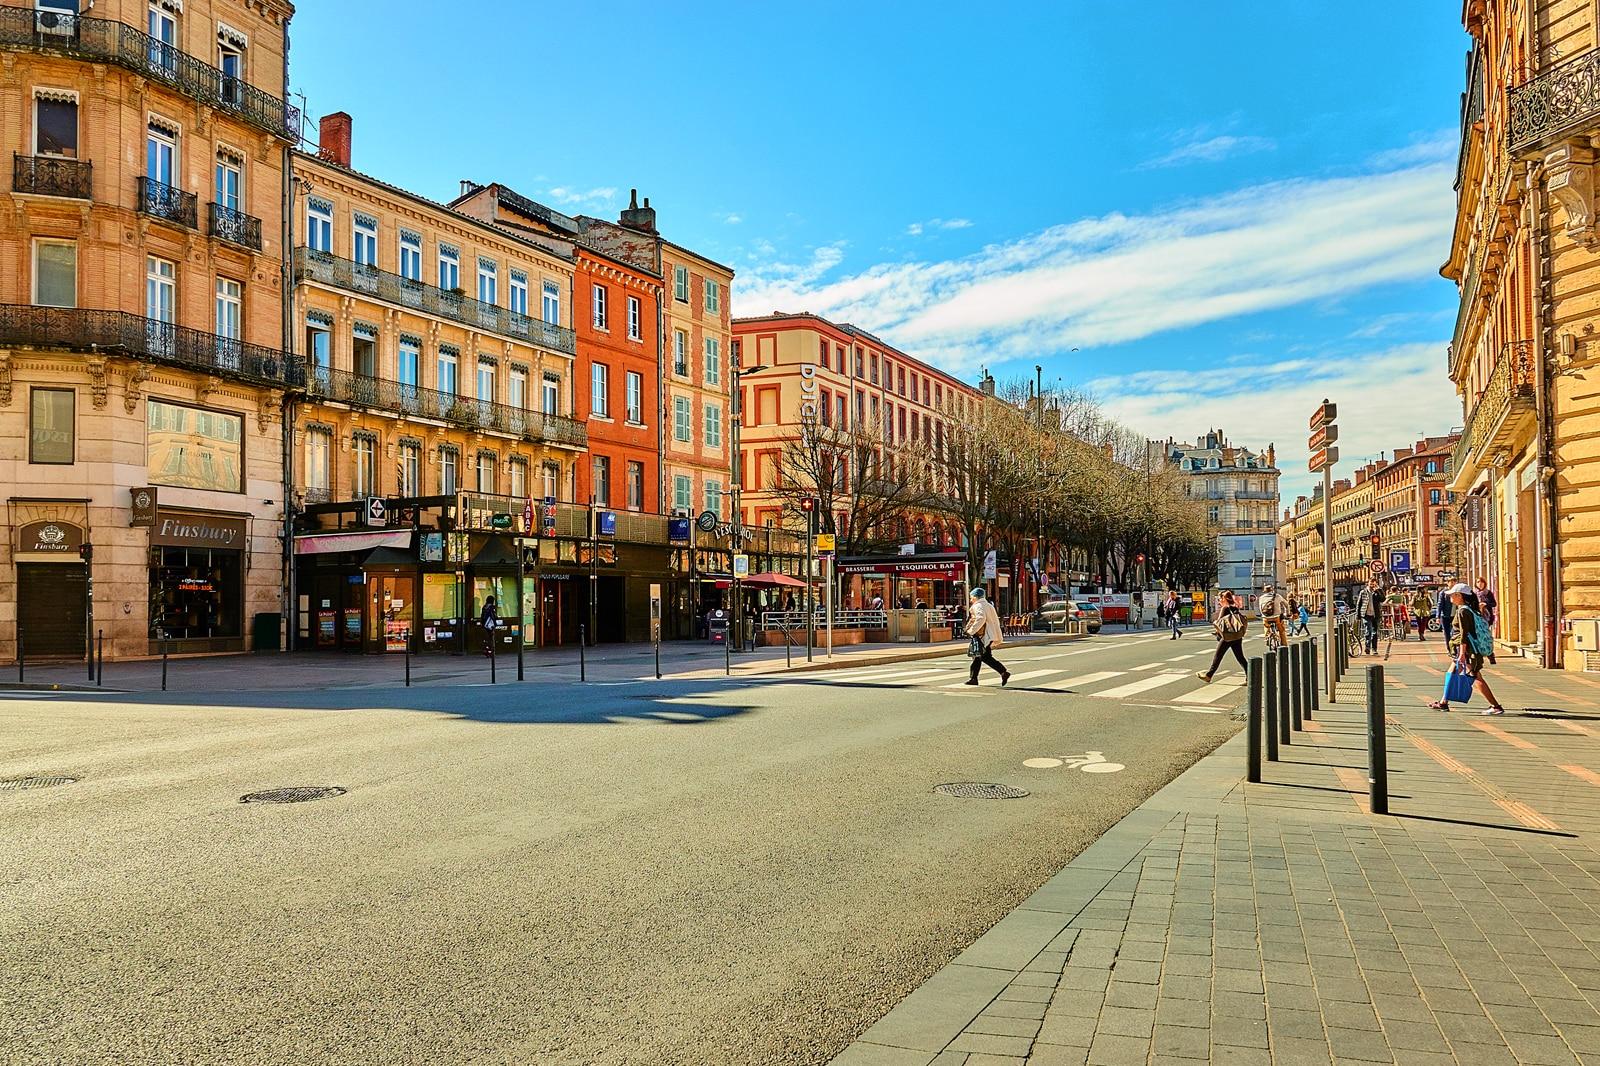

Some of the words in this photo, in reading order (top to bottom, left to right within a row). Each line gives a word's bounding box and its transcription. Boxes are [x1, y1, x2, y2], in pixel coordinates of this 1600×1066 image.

[160, 519, 237, 544] Finsbury
[34, 543, 70, 551] Finsbury
[1393, 554, 1404, 566] P
